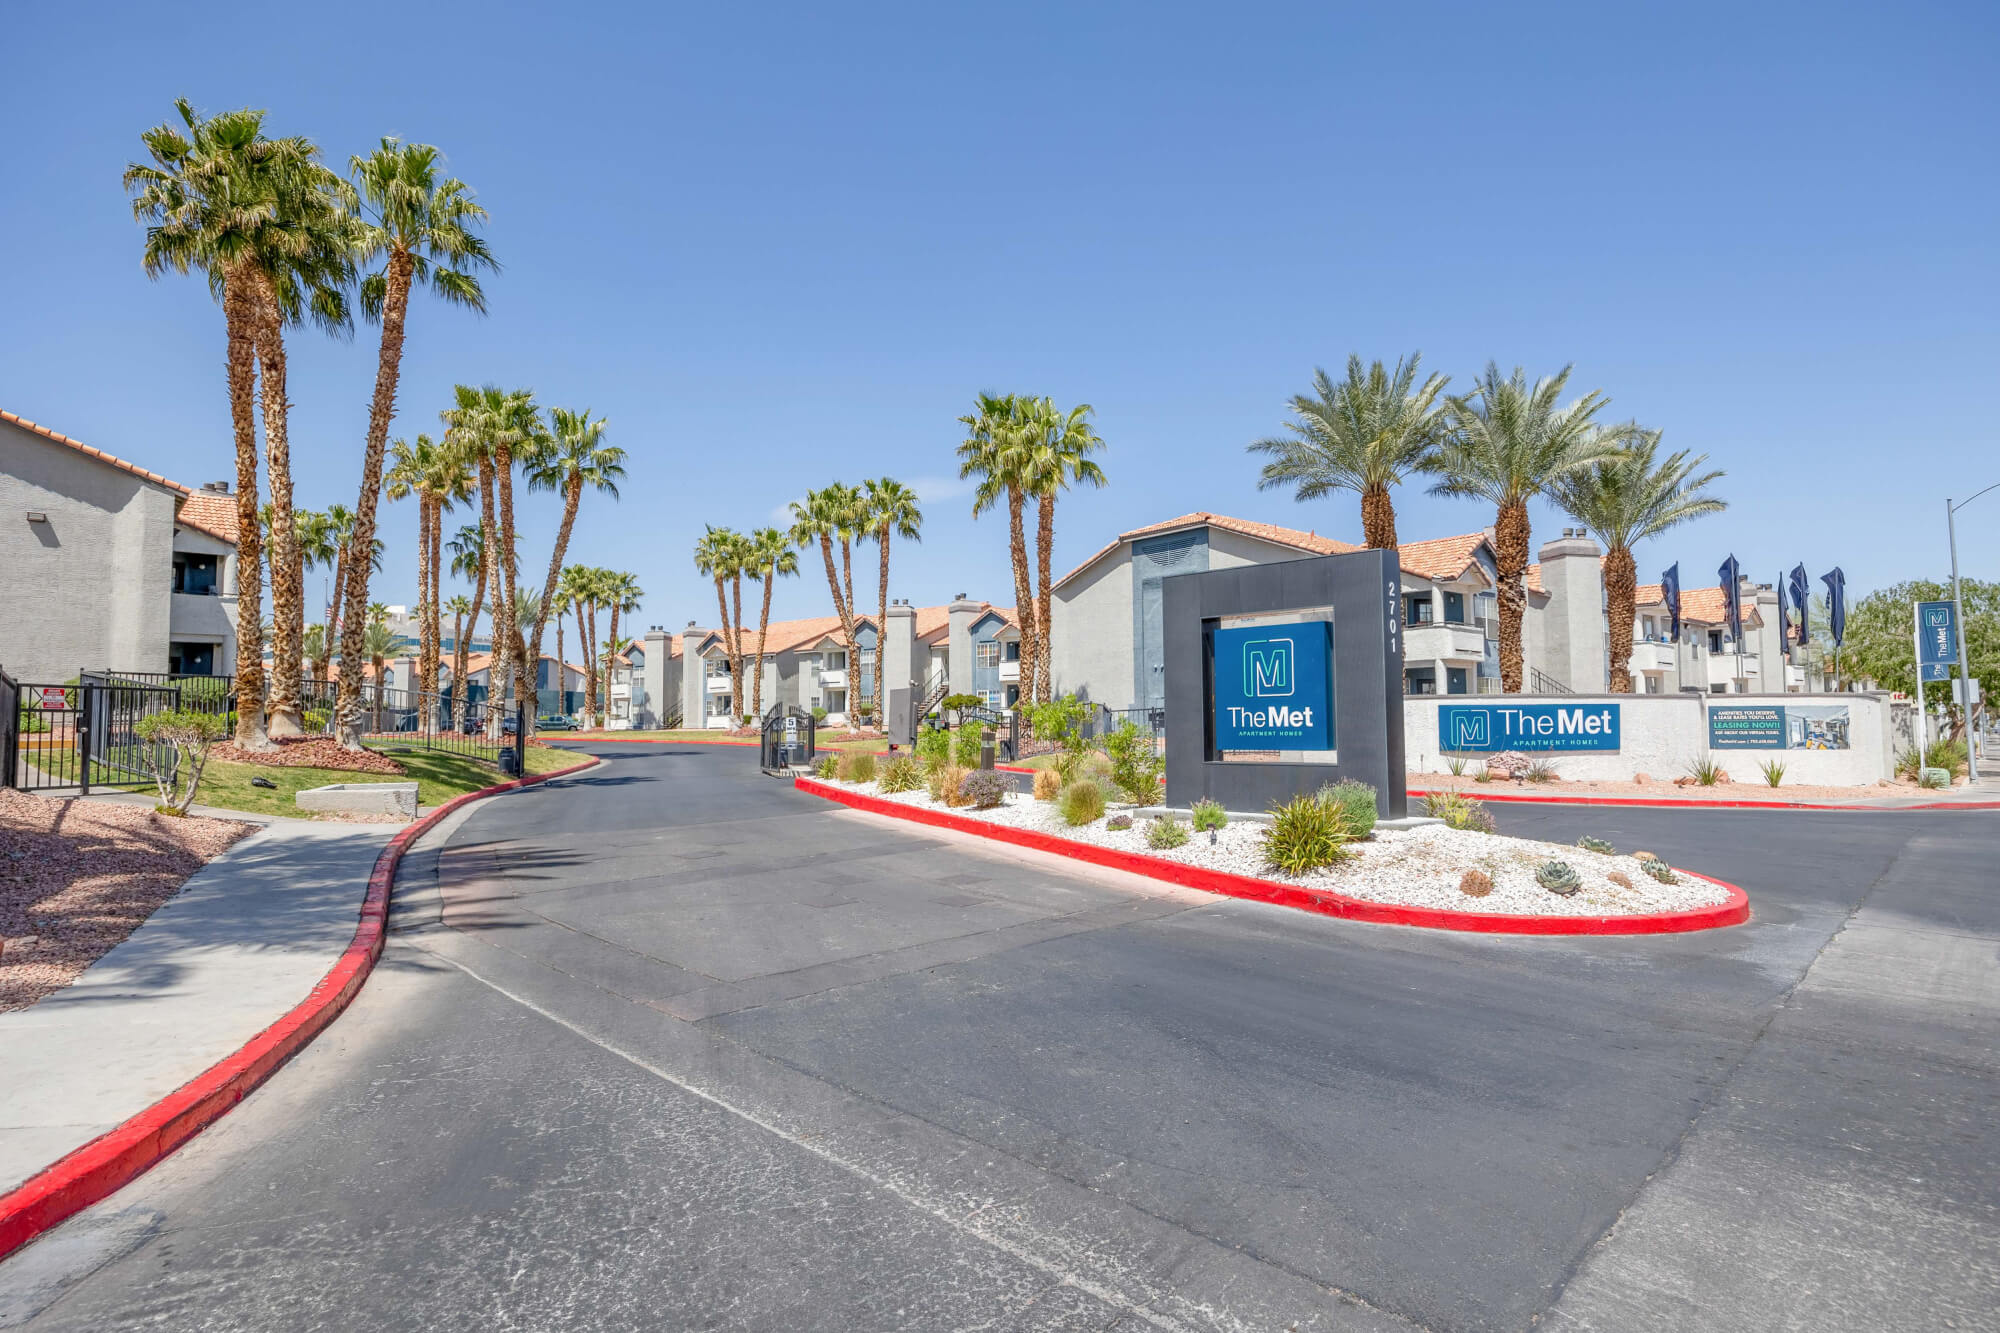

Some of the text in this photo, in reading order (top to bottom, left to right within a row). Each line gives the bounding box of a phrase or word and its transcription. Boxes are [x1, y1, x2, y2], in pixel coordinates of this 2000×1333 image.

[1388, 581, 1397, 653] 2701
[788, 718, 794, 726] 5
[1713, 721, 1750, 729] LEASING
